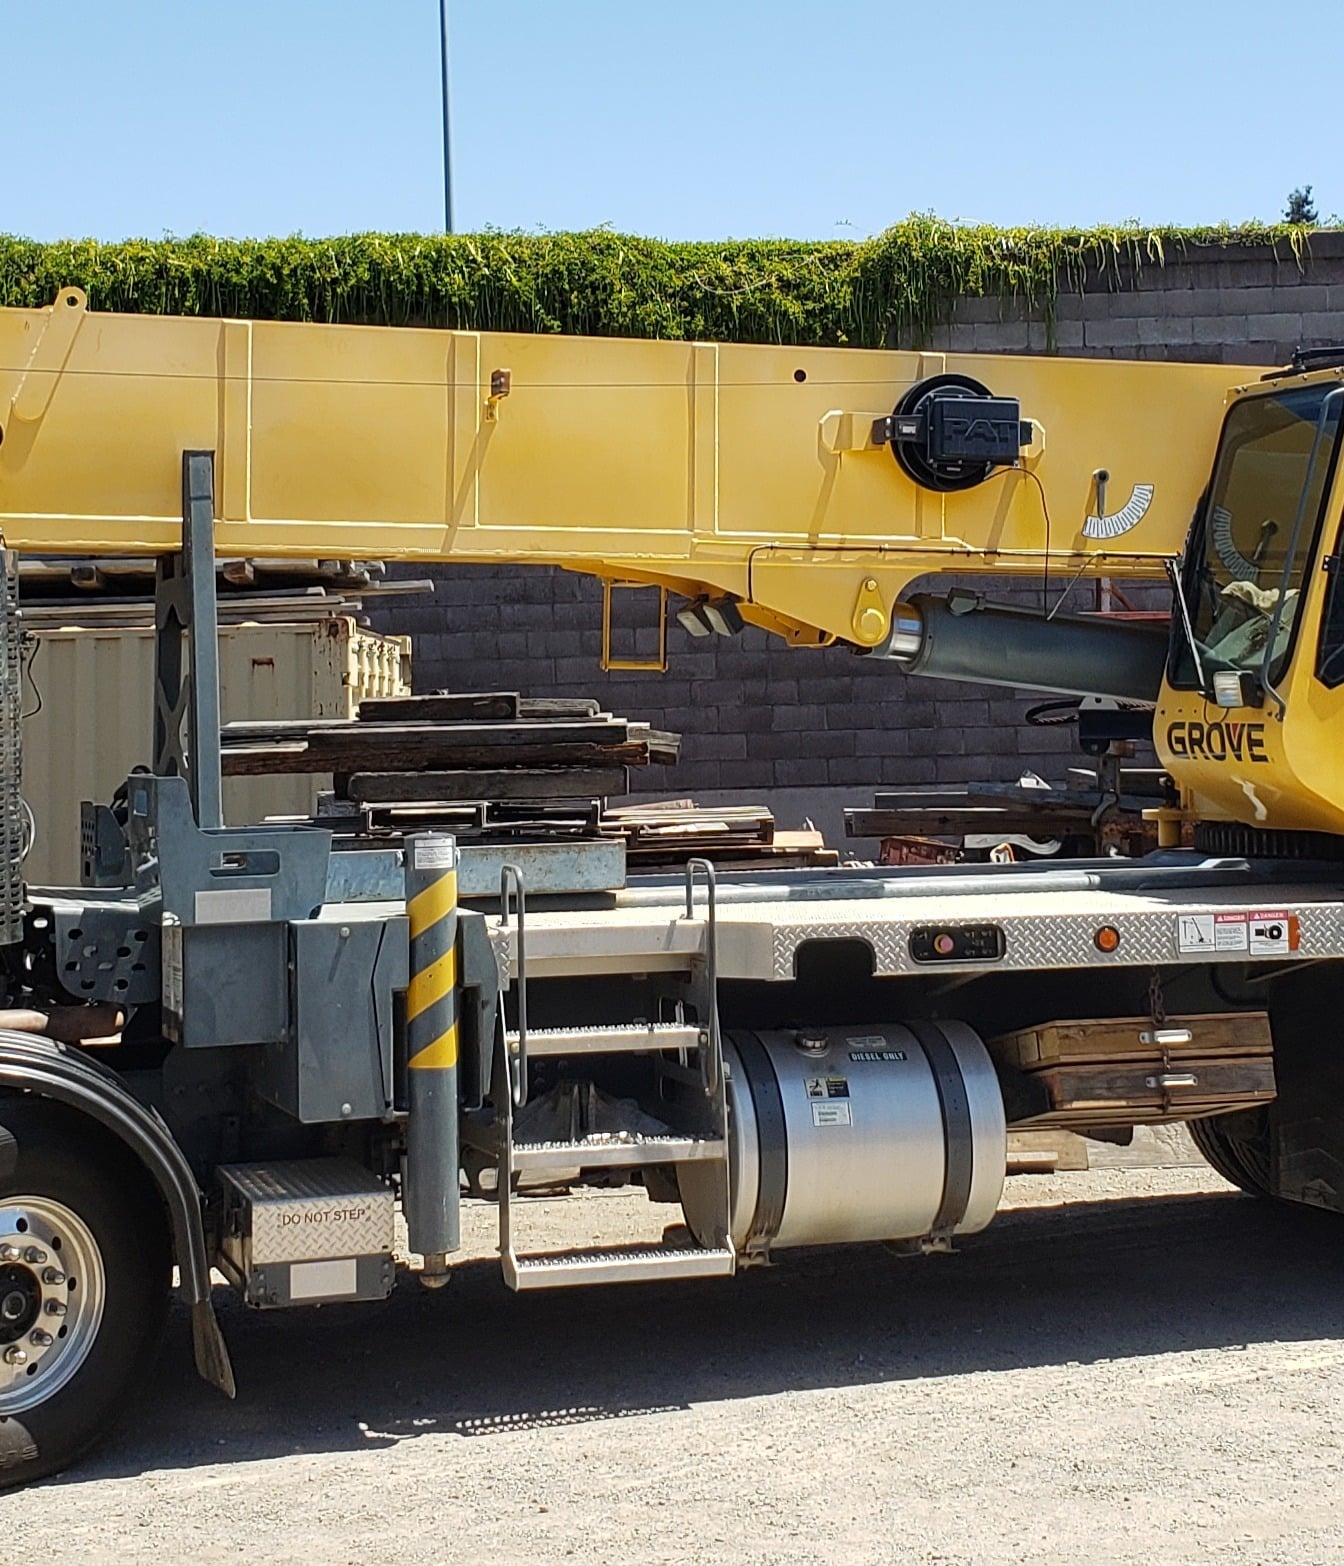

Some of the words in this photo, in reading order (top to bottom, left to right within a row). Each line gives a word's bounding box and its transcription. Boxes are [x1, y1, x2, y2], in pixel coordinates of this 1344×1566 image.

[1167, 722, 1269, 762] GROVE
[851, 1052, 881, 1061] DIESEL
[882, 1052, 904, 1060] ONLY
[282, 1214, 300, 1226] DO
[304, 1211, 331, 1224] NOT
[334, 1208, 365, 1221] STEP
